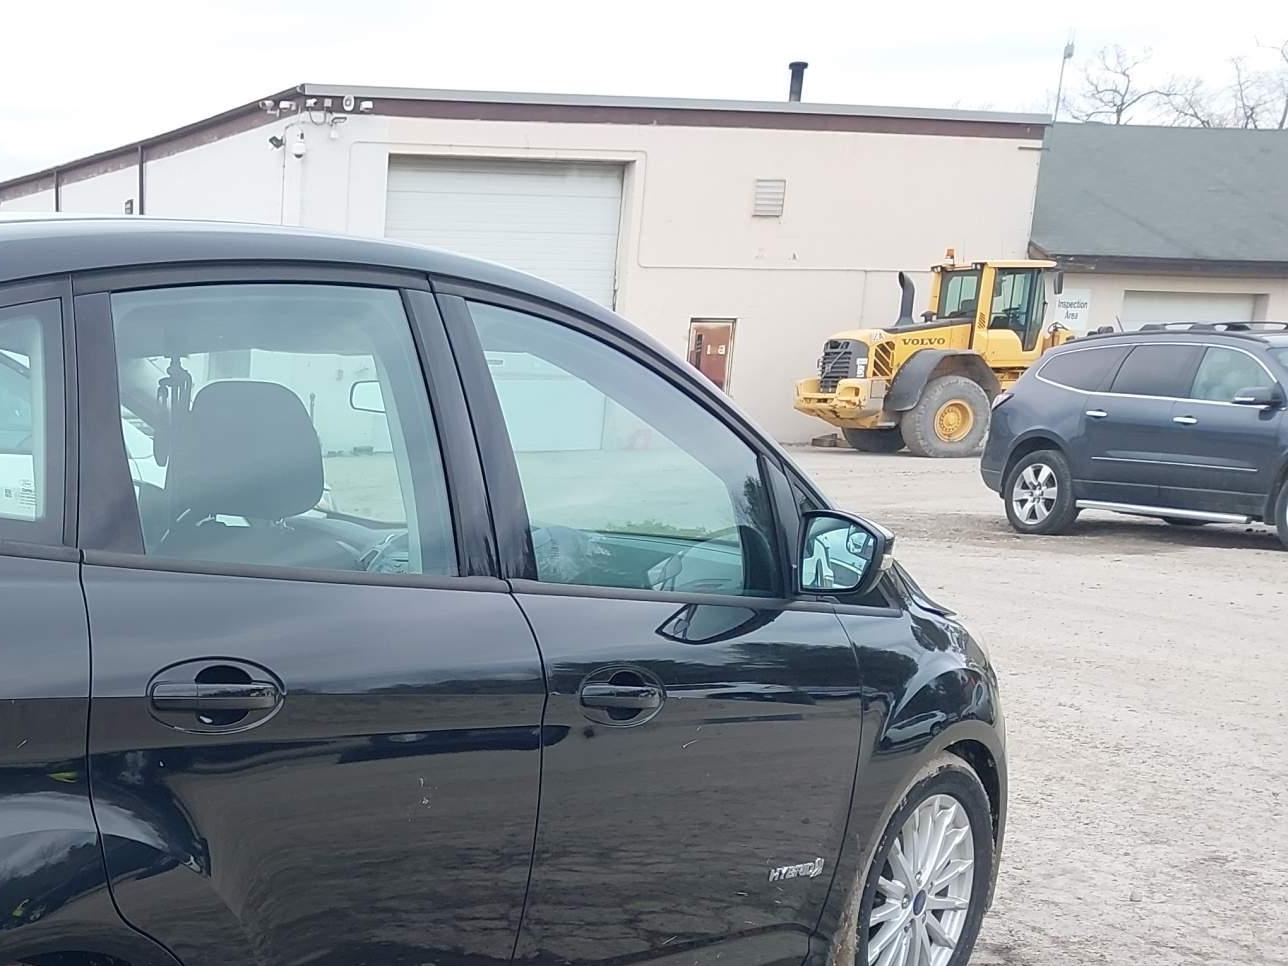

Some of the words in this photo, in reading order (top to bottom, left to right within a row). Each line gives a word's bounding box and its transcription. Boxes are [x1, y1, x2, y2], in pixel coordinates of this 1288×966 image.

[1058, 297, 1088, 309] Inspection
[1065, 309, 1079, 320] Area
[902, 337, 946, 346] VOLVO
[768, 862, 815, 882] HYBRID
